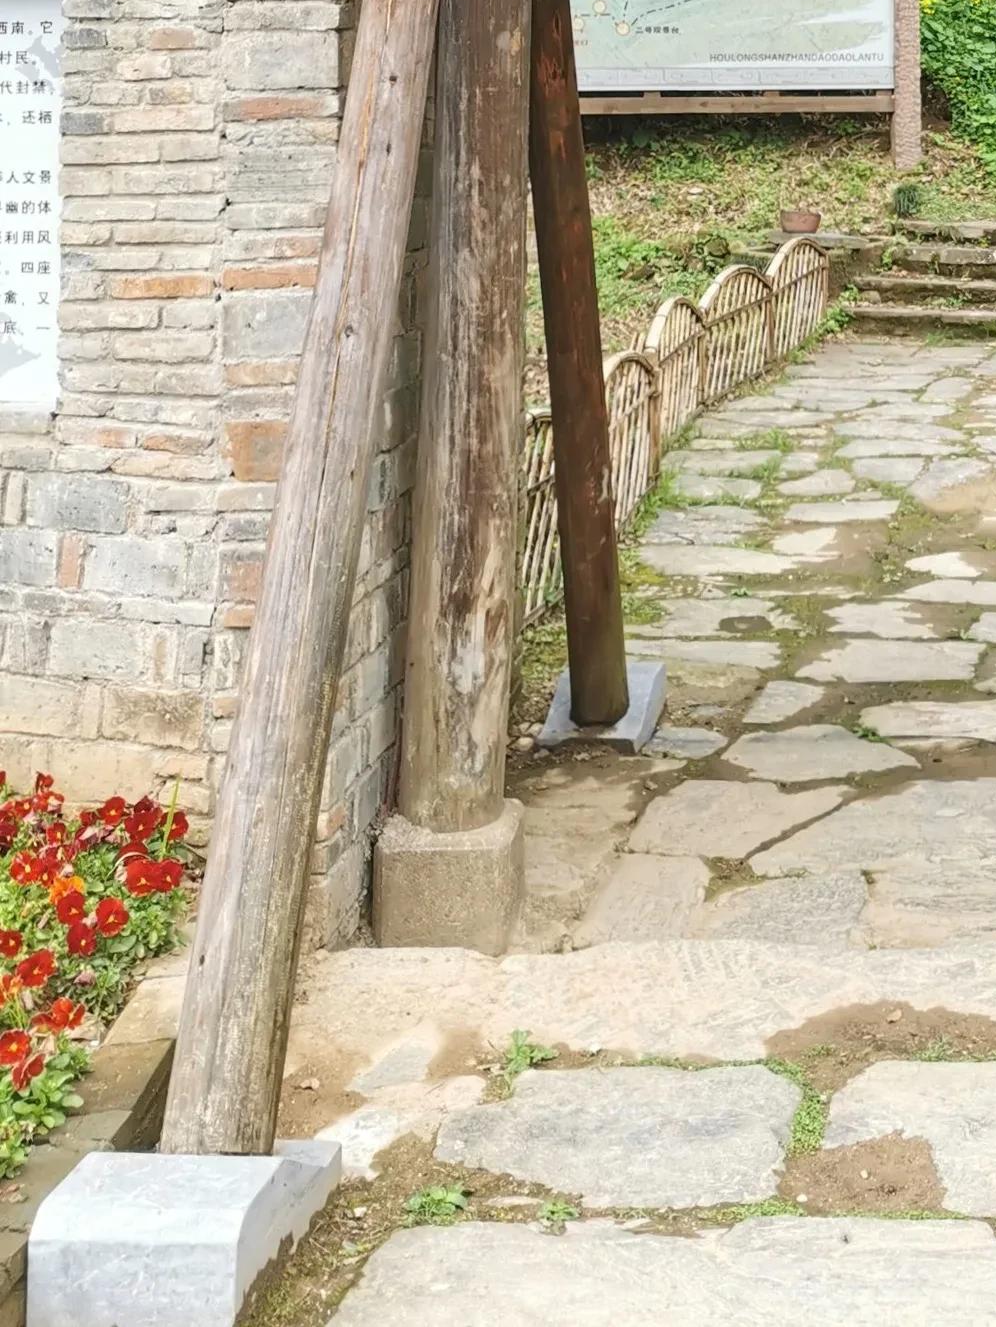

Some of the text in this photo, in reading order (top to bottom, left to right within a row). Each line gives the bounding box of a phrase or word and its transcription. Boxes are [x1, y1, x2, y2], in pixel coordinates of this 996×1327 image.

[0, 170, 52, 185] 人文景
[0, 200, 52, 215] 幽的体
